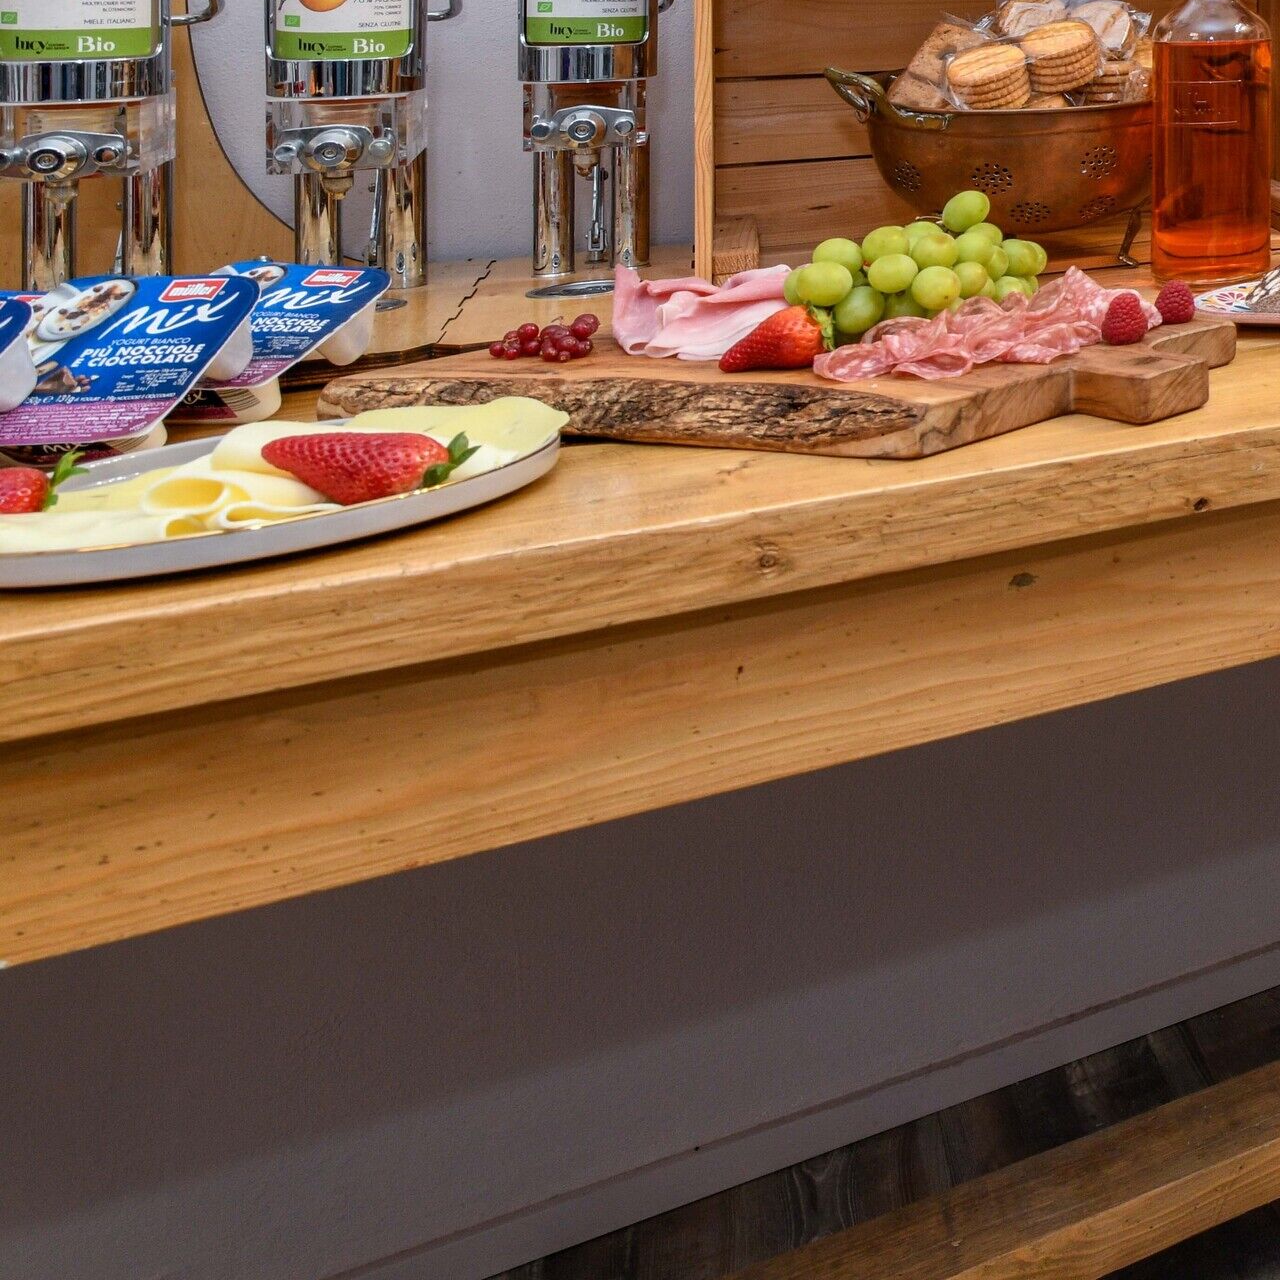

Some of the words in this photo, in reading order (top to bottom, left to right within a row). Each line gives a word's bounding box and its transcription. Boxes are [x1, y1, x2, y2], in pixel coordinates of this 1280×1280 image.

[107, 17, 137, 25] ITALIANO
[596, 22, 625, 38] Bio
[77, 35, 116, 53] Bio
[353, 38, 386, 54] Bio
[310, 272, 353, 283] müller
[169, 283, 218, 297] müller
[250, 324, 323, 334] OCCOLATO
[253, 317, 331, 327] NOCCIOLE
[111, 337, 150, 346] YOGURT
[150, 336, 191, 345] BIANCO
[80, 344, 112, 359] PIÙ
[114, 343, 206, 357] NOCCIOLE
[71, 357, 85, 368] E
[87, 353, 200, 367] CIOCCOLATO
